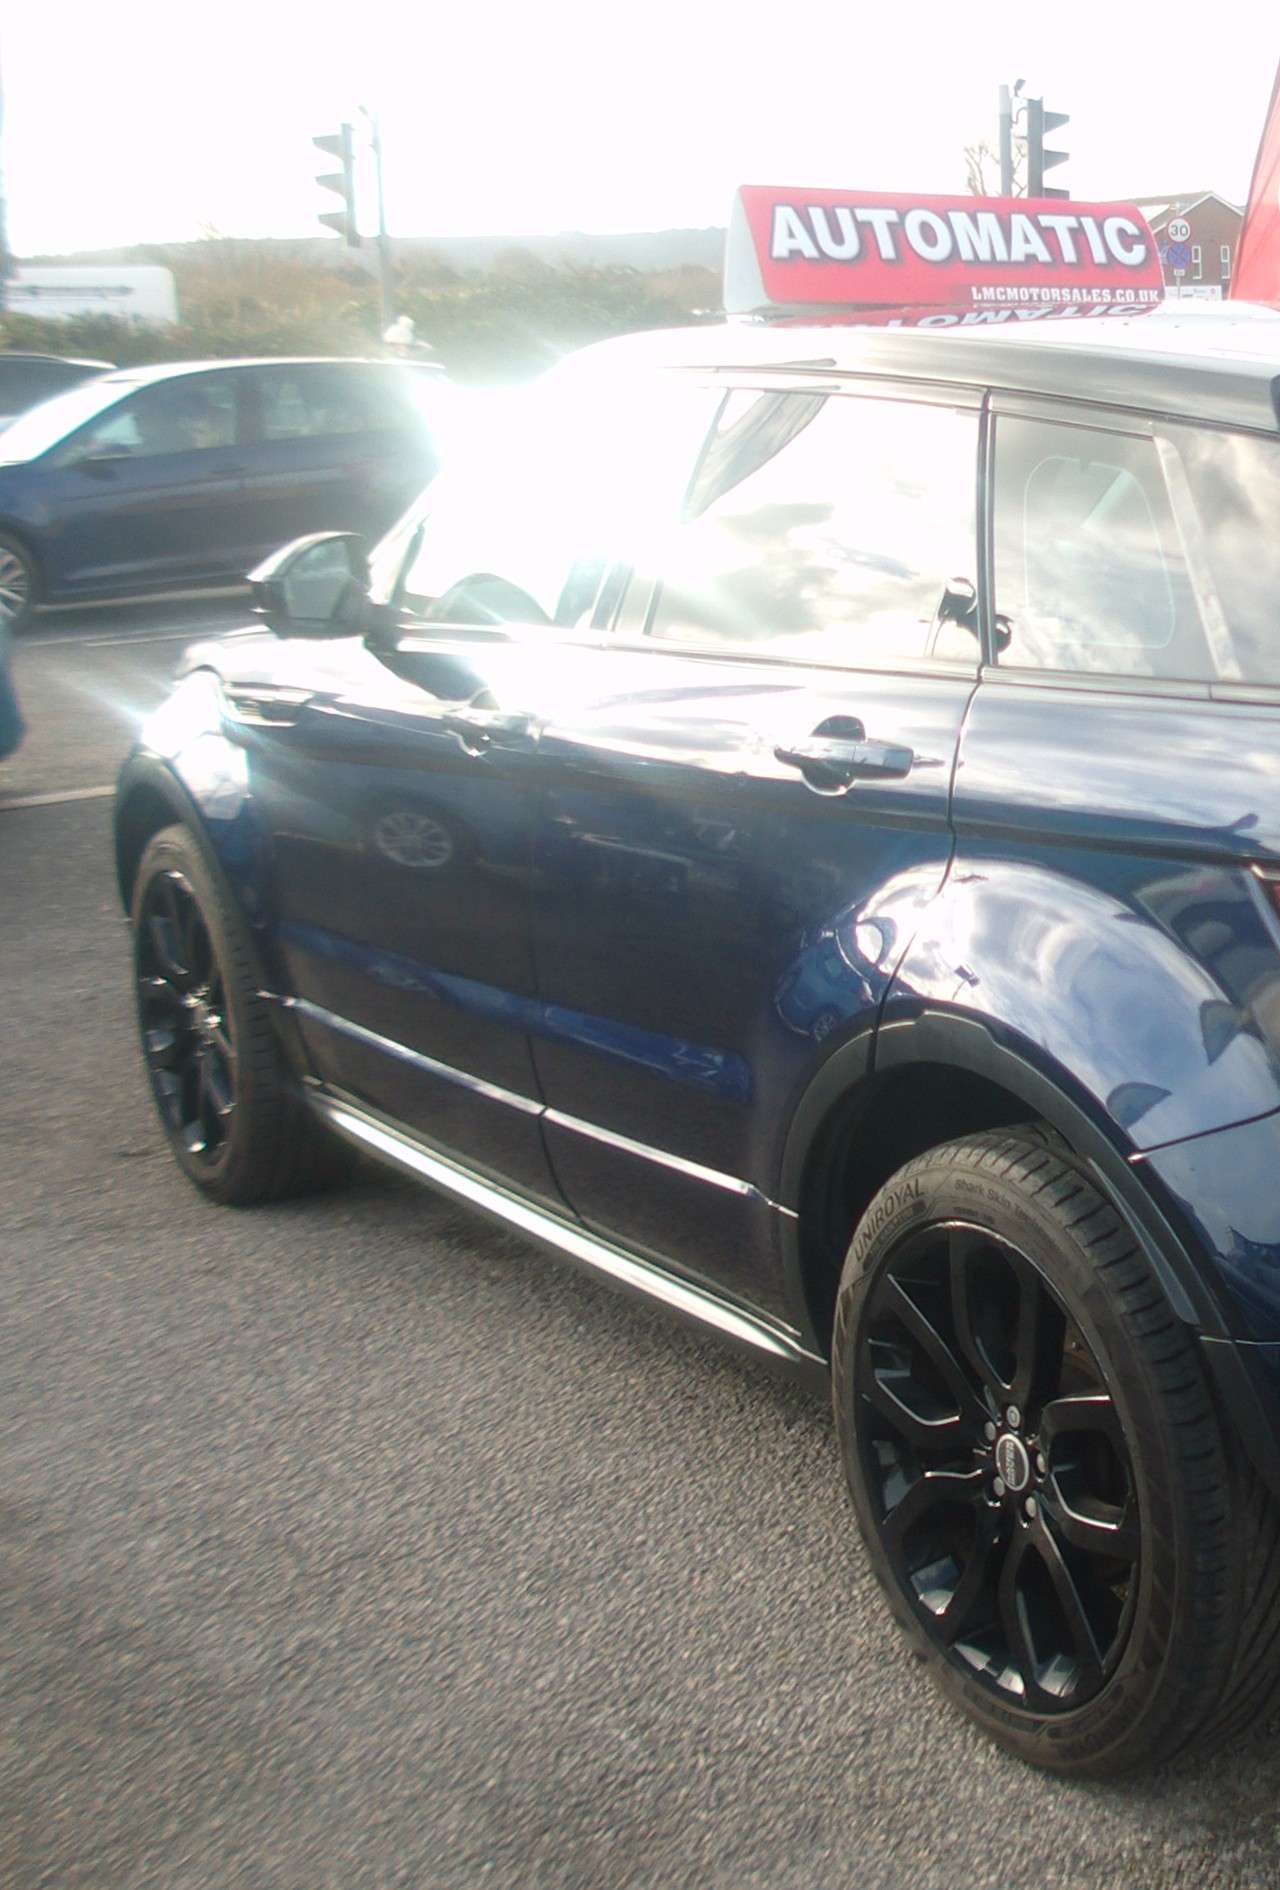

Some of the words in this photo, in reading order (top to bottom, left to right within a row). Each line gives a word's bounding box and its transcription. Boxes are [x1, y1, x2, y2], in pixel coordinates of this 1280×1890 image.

[771, 204, 1147, 267] AUTOMATIC
[1170, 224, 1188, 237] 30
[971, 286, 1161, 304] LMCMOTORSALES.CO.UK
[854, 1178, 926, 1263] UNIROYAL
